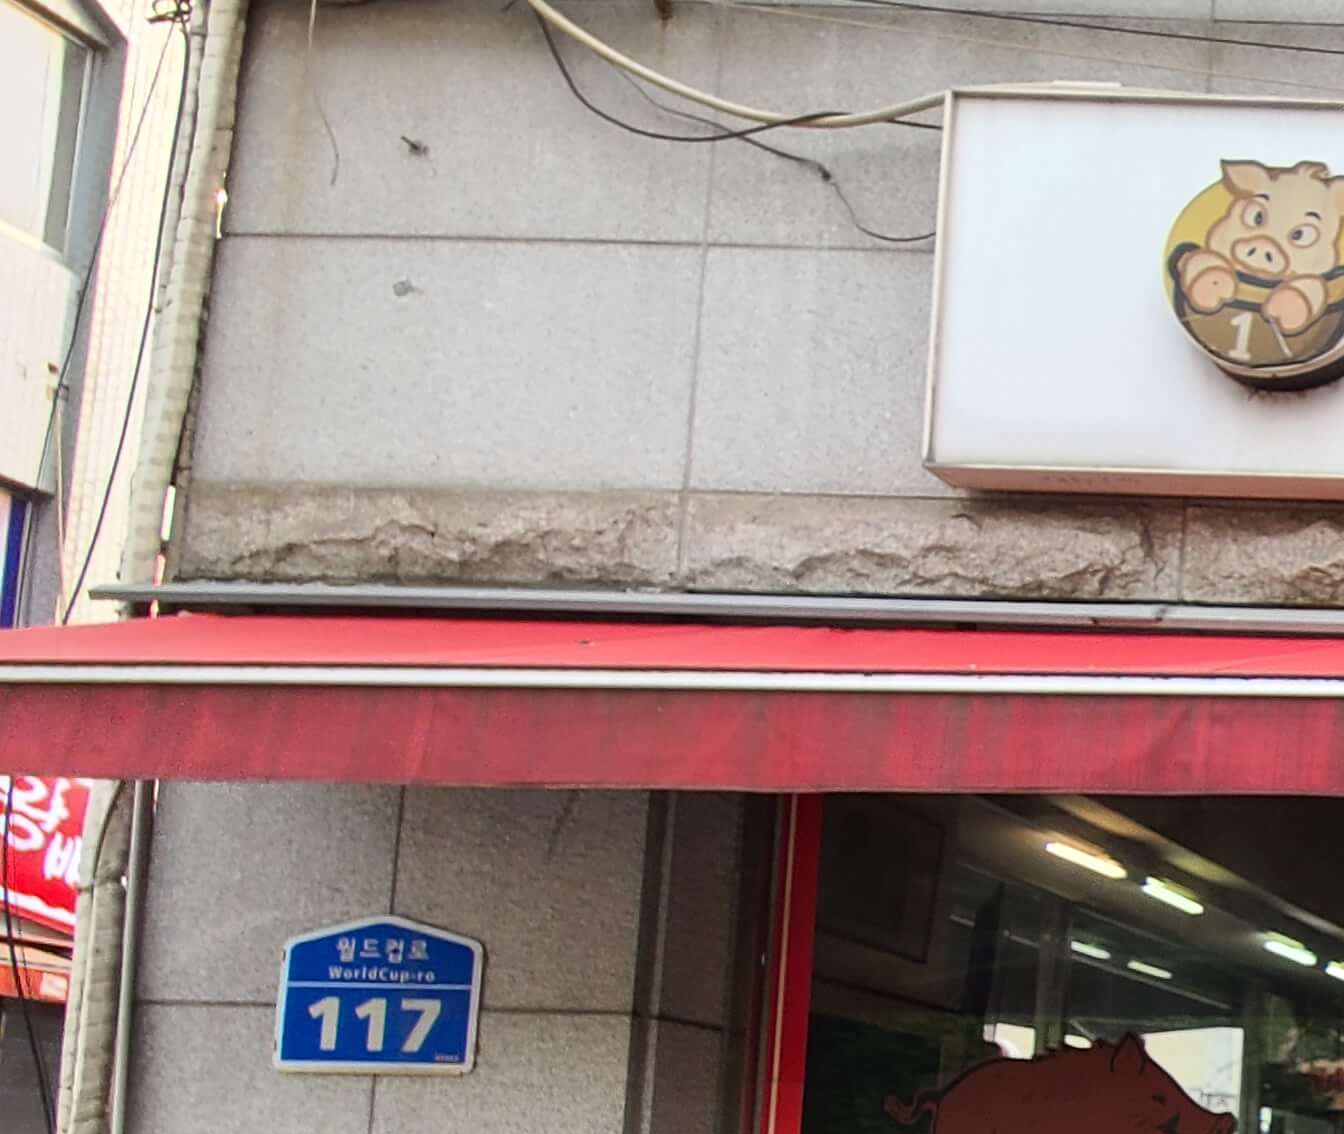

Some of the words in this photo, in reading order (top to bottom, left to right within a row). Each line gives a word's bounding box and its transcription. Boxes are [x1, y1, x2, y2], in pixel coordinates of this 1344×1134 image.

[337, 936, 430, 964] 월드컵로
[328, 965, 436, 984] WorldCup-ro
[308, 996, 441, 1053] 117
